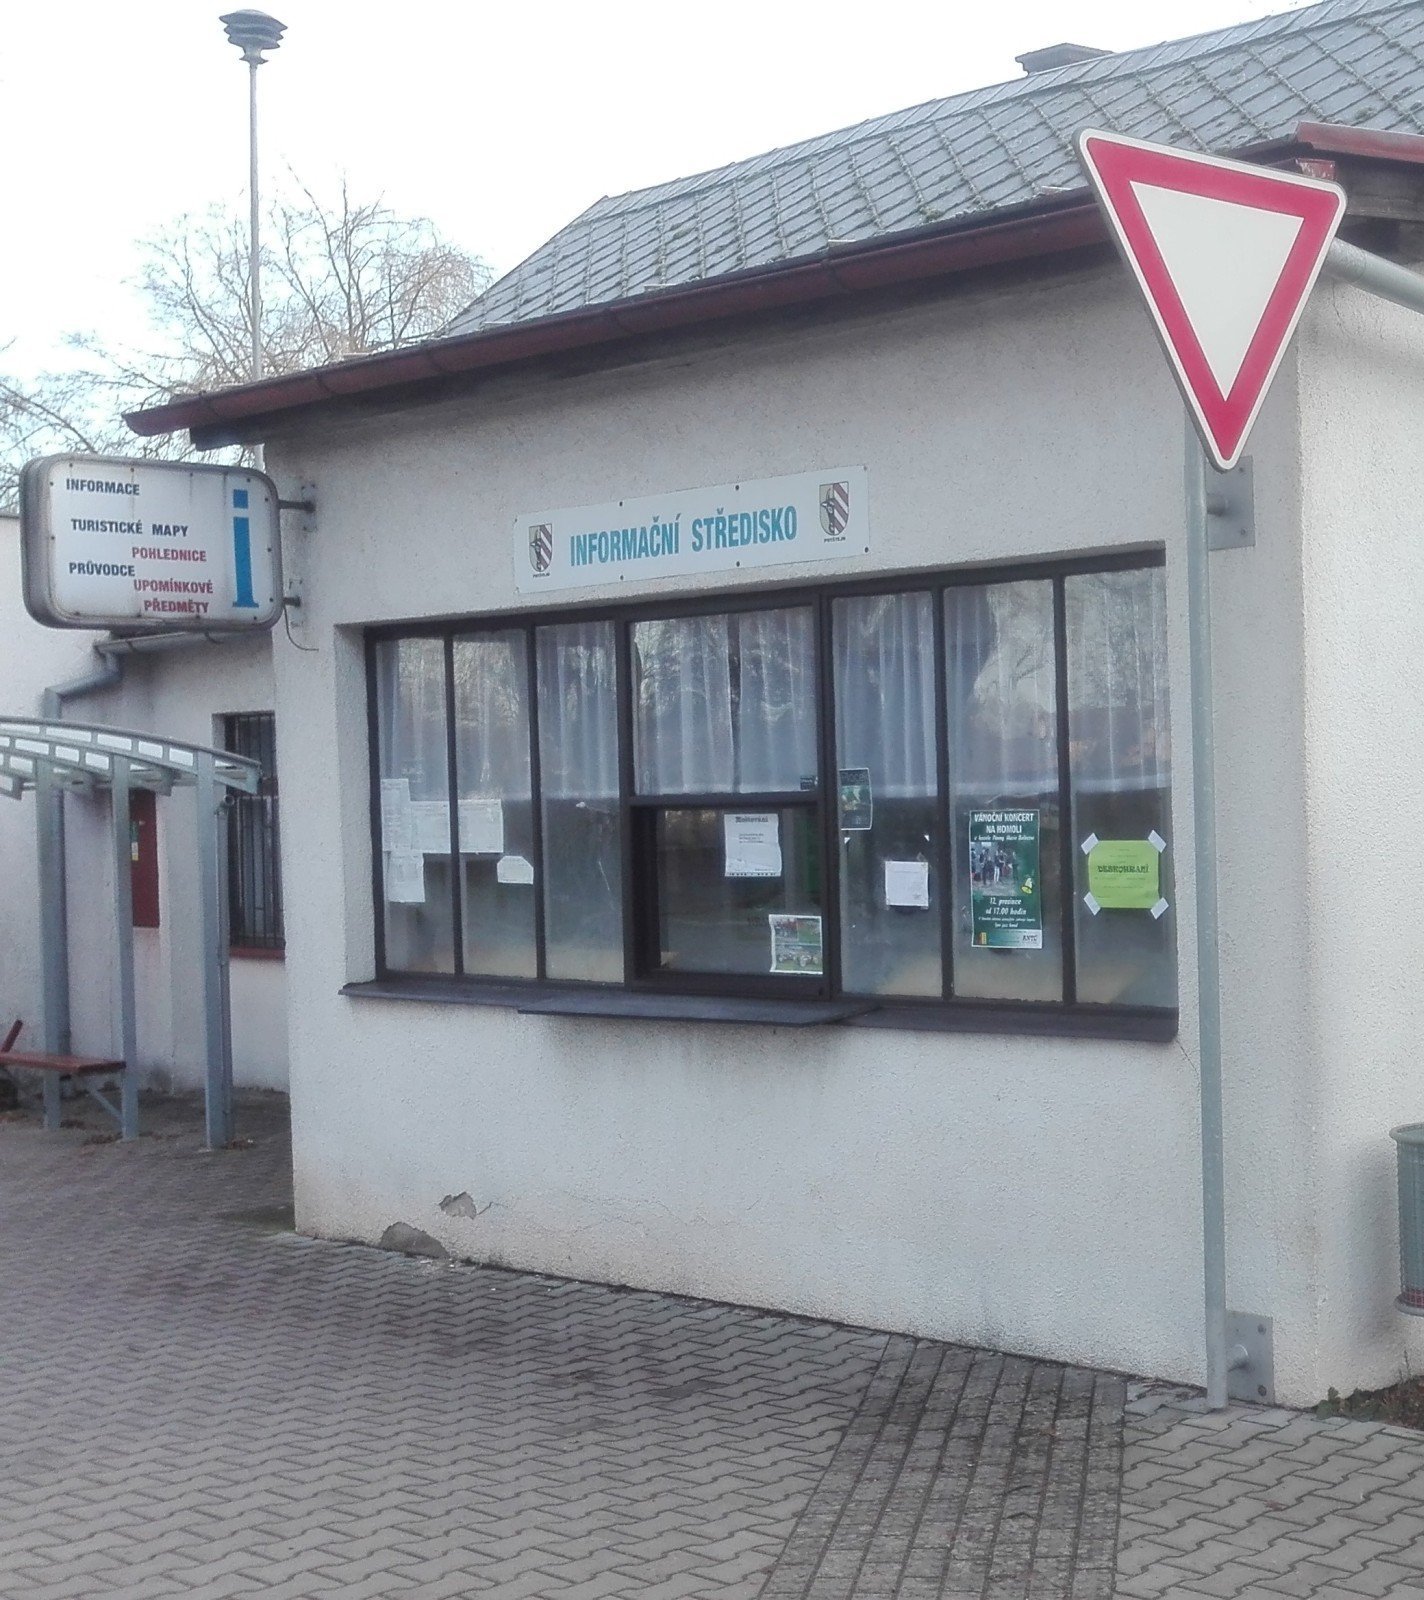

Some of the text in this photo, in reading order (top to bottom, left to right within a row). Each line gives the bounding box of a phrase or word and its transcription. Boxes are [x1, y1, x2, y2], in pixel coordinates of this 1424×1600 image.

[66, 478, 140, 496] INFORMACE
[71, 518, 189, 537] TURISTICKÉ MAPY
[570, 505, 797, 567] INFORMAČNÍ STŘEDISKO
[132, 546, 207, 562] POHLEDNICE
[69, 561, 136, 577] PRŮVODCE
[133, 577, 214, 594] UPOMÍNKOVÉ
[143, 598, 209, 614] PŘEDMĚTY
[974, 811, 1034, 822] VÁNOČNÍ KONCERT
[986, 825, 1022, 833] NA HOMOLI
